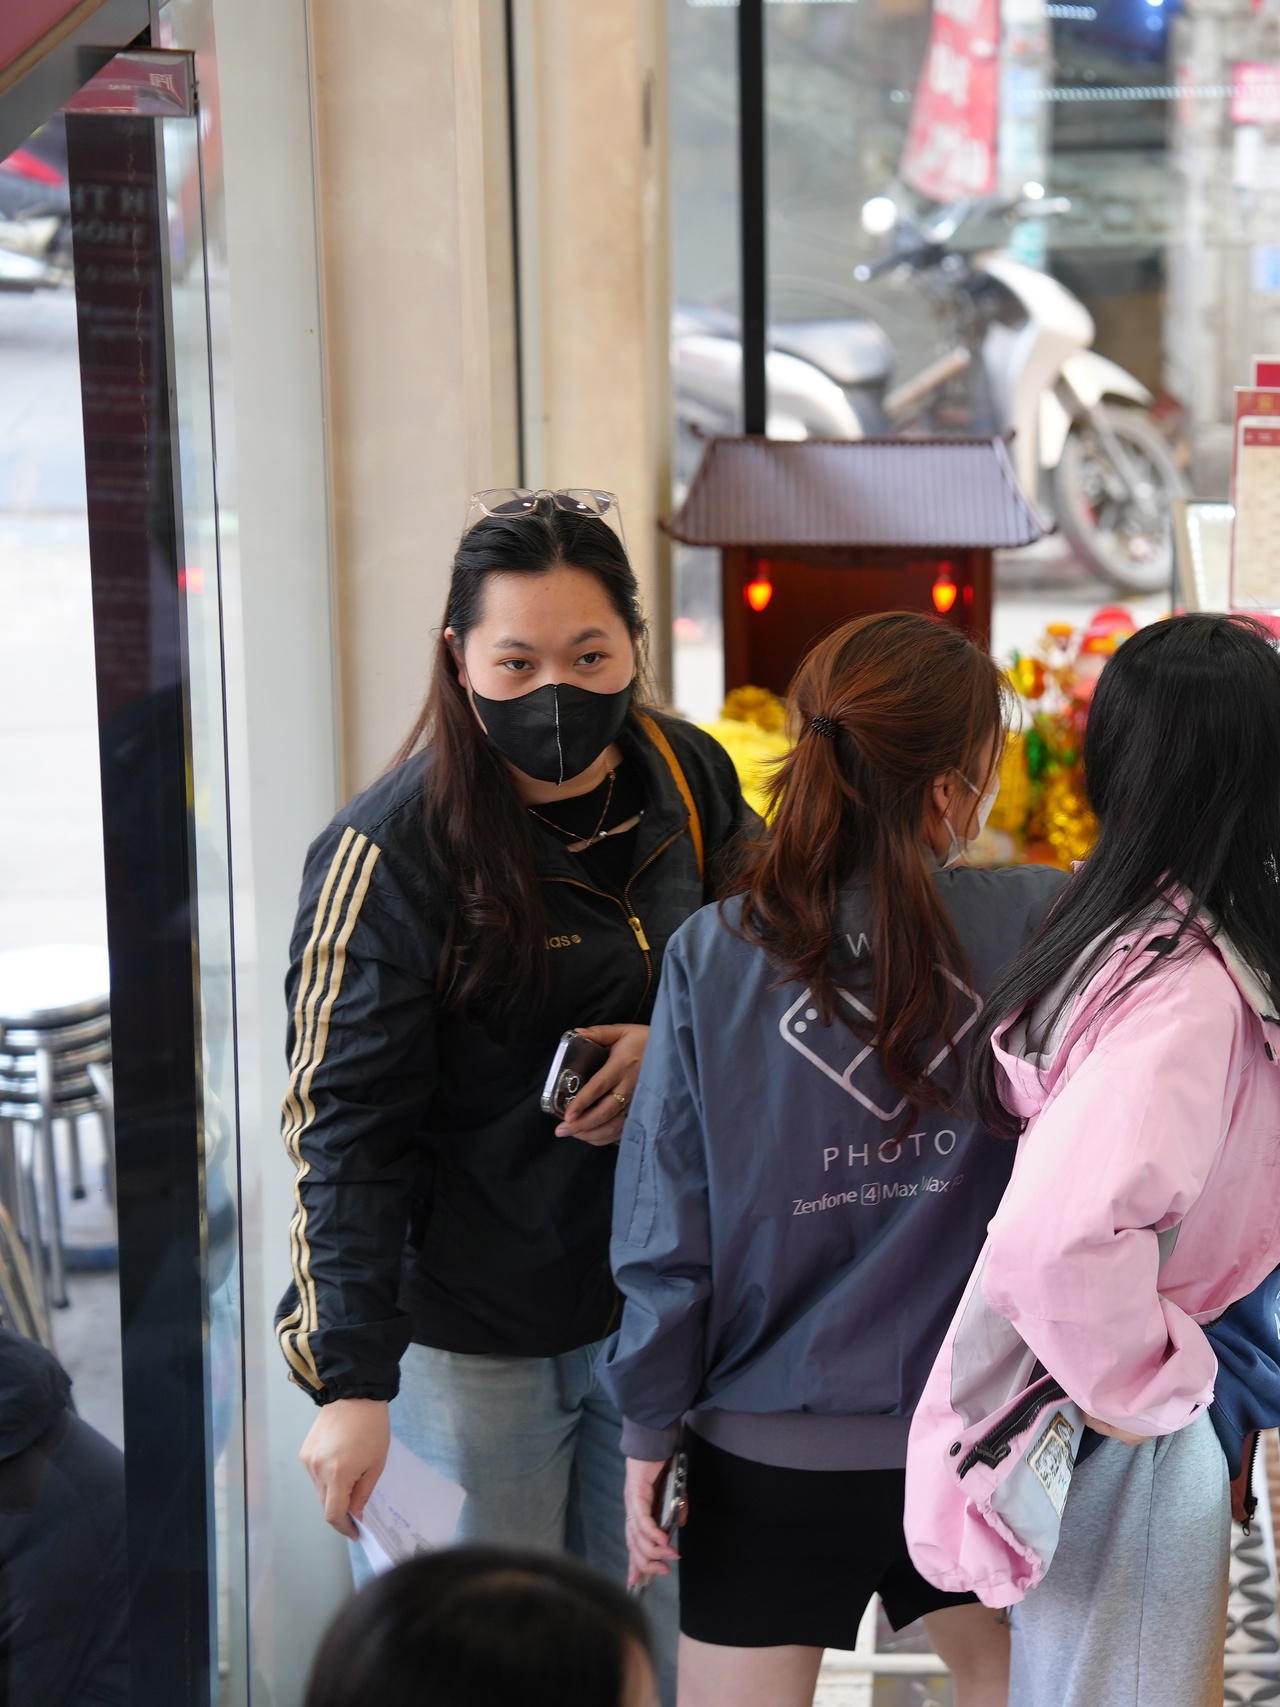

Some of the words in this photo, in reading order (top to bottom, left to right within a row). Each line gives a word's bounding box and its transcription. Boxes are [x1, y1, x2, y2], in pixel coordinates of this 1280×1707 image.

[823, 1129, 957, 1172] PHOTO
[792, 1190, 858, 1215] Zenfone
[863, 1185, 878, 1203] 4
[883, 1182, 919, 1200] Max
